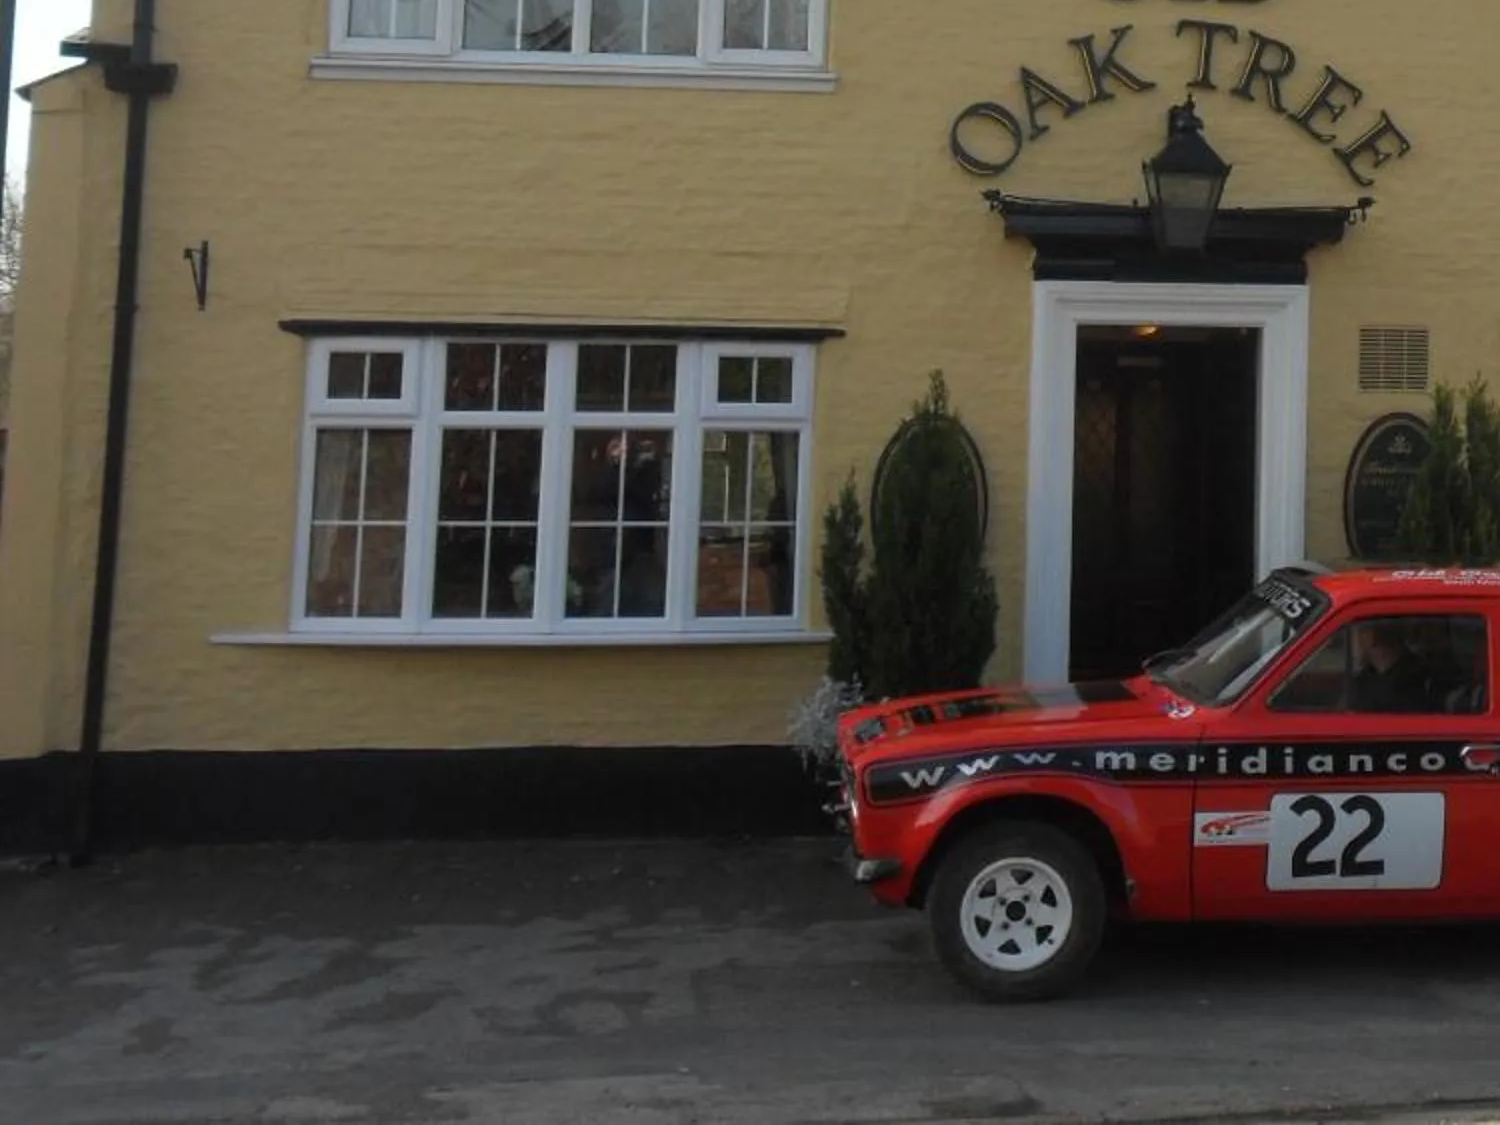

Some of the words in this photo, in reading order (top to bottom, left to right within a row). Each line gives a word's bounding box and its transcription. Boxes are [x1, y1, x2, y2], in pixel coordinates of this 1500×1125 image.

[950, 24, 1156, 174] OAK
[1175, 19, 1411, 187] TREE
[1290, 794, 1386, 877] 22
